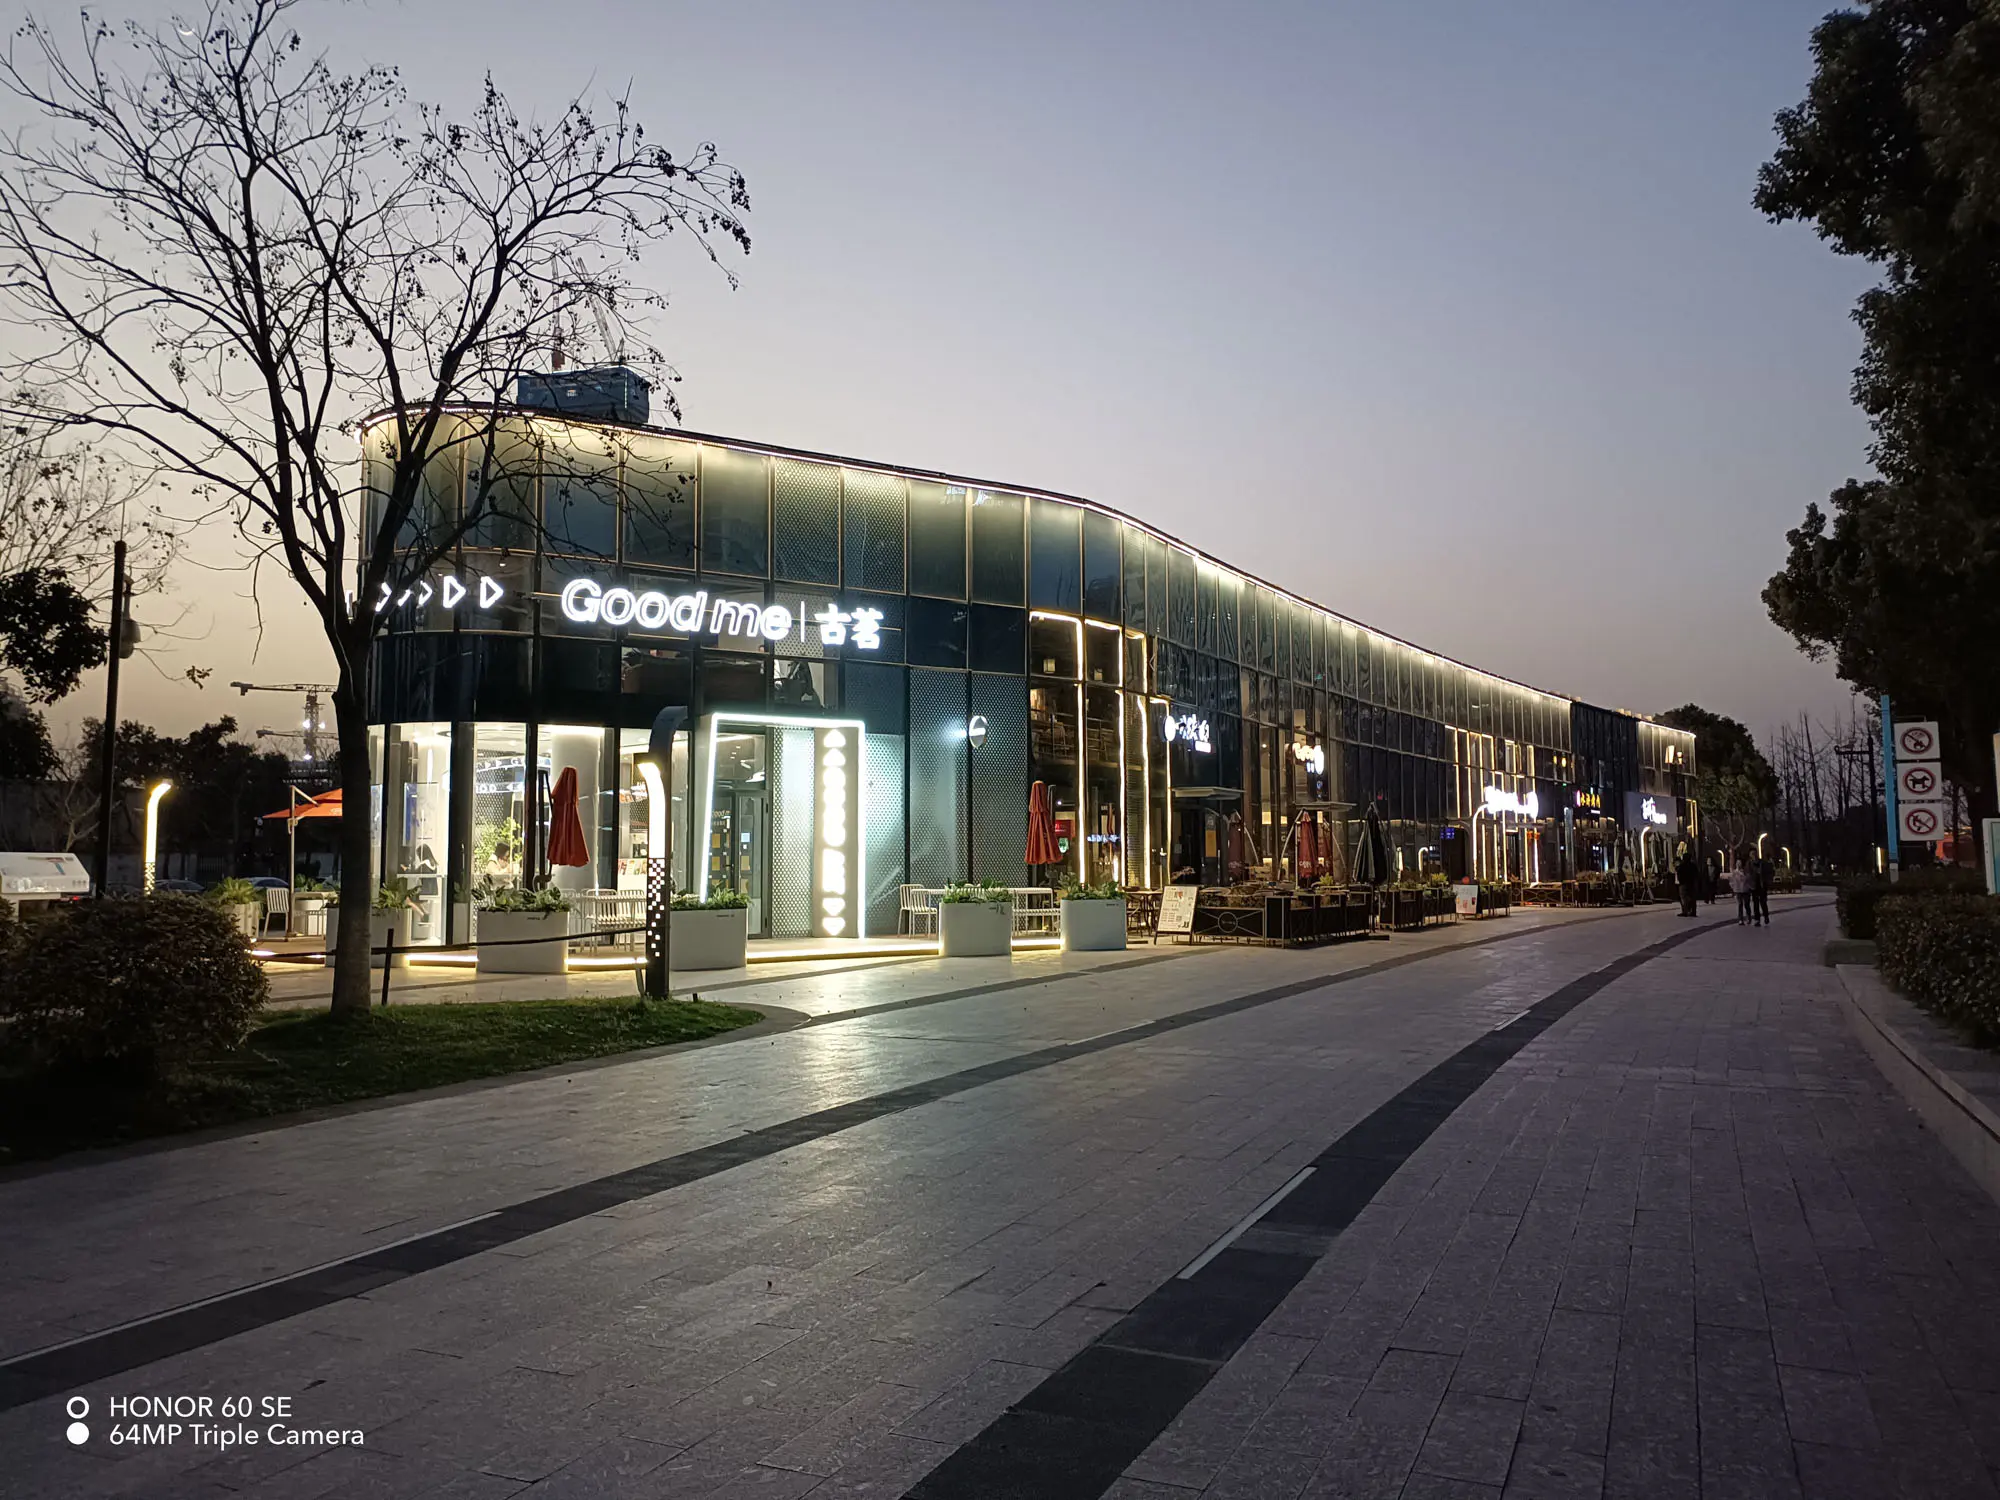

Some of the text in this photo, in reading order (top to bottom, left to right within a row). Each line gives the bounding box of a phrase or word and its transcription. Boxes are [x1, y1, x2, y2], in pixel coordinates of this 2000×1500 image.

[561, 578, 792, 641] Good me
[814, 603, 884, 649] 古茗
